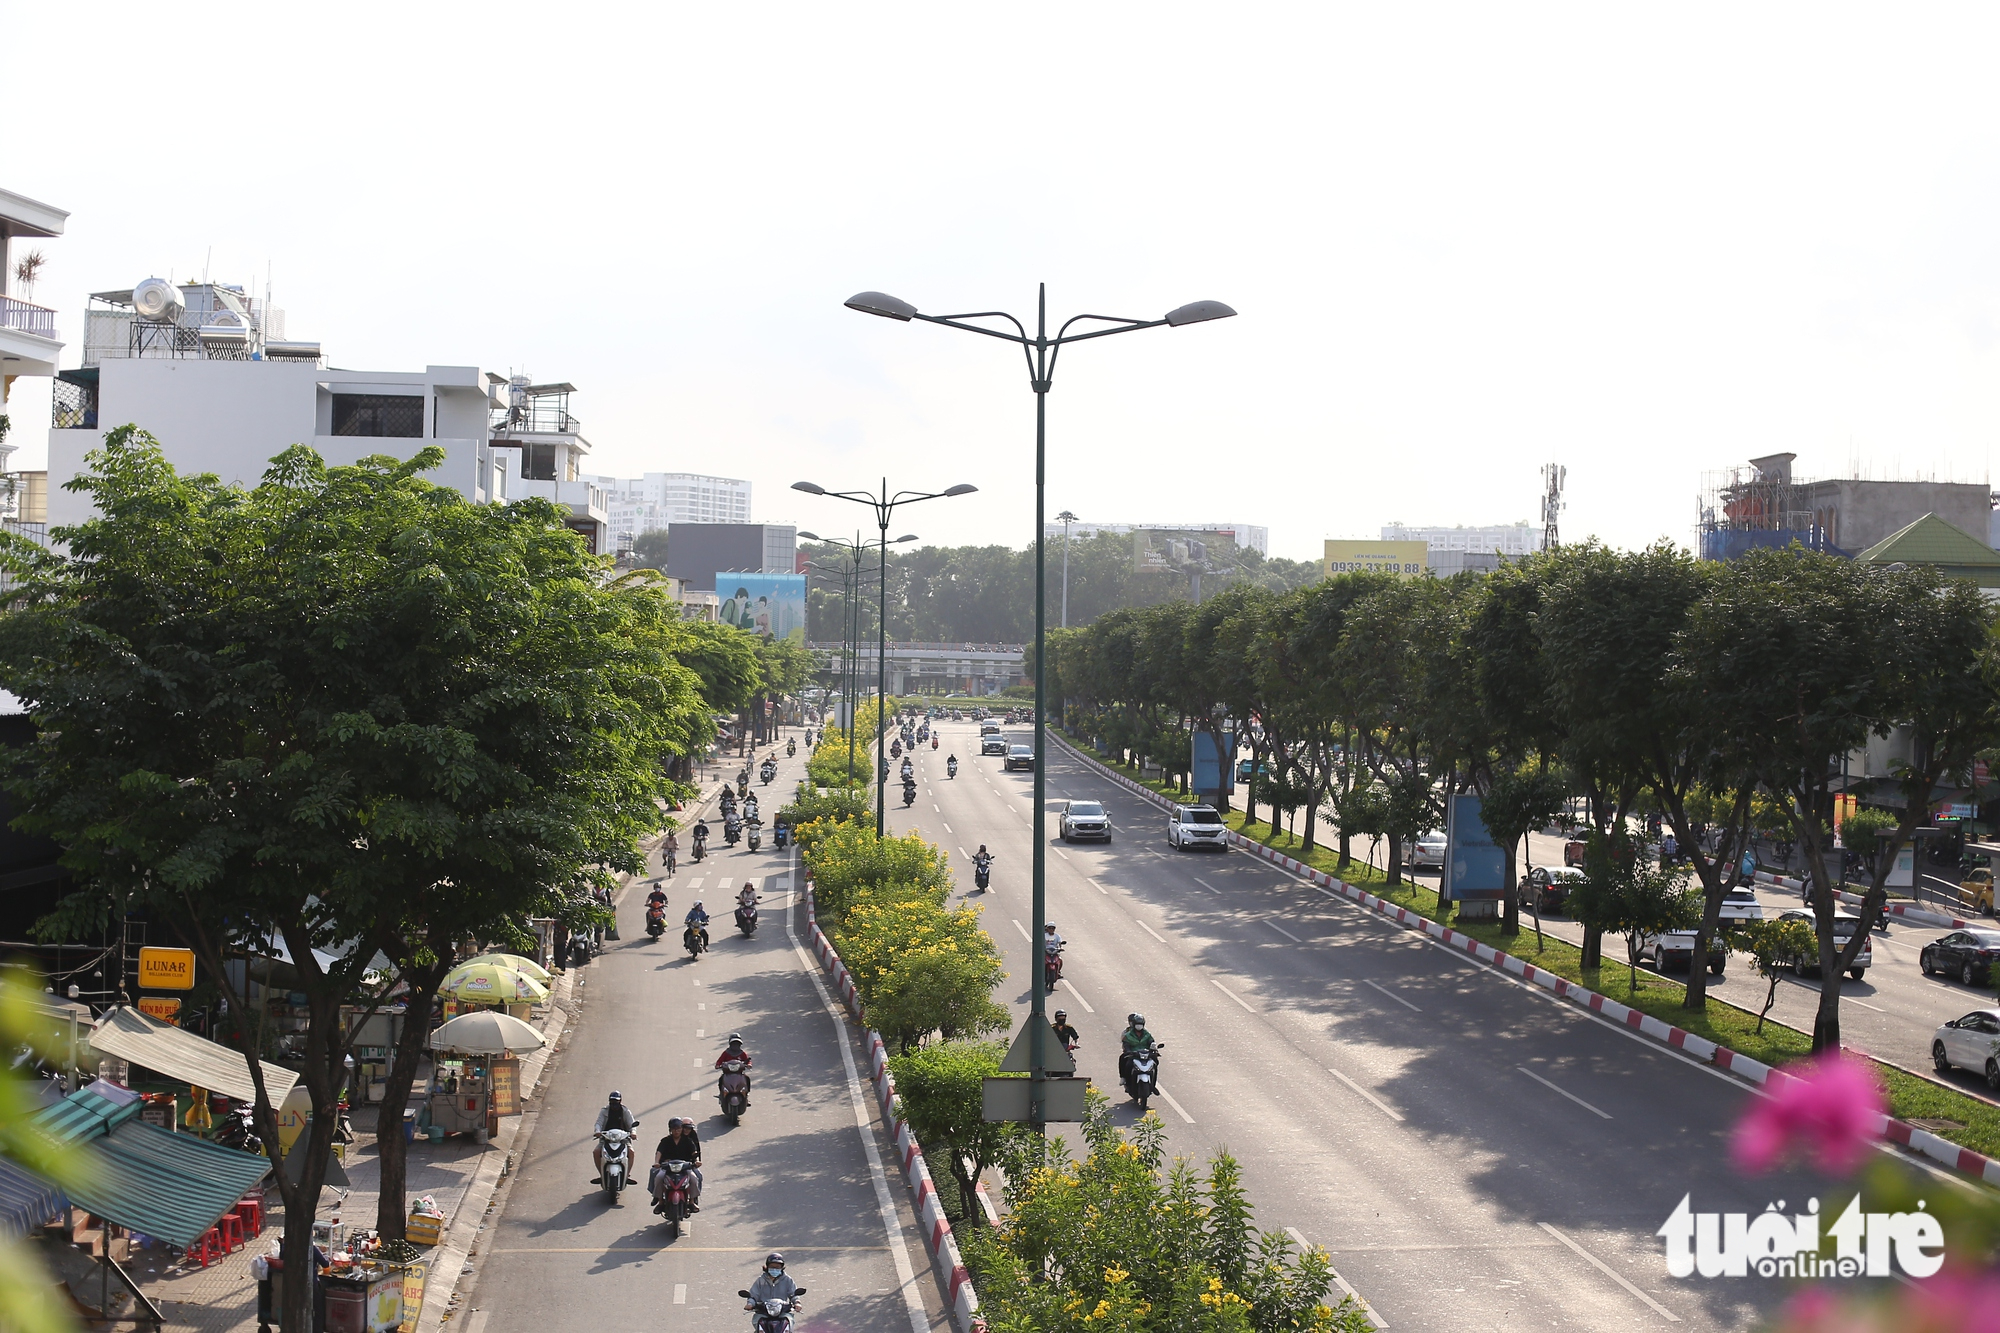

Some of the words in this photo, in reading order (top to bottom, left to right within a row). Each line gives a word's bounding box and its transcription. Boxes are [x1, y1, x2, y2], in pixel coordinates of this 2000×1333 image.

[146, 961, 186, 973] LUNAR
[140, 1002, 154, 1014] BÚN
[155, 1003, 163, 1014] BÒ
[164, 1002, 179, 1014] HUẾ
